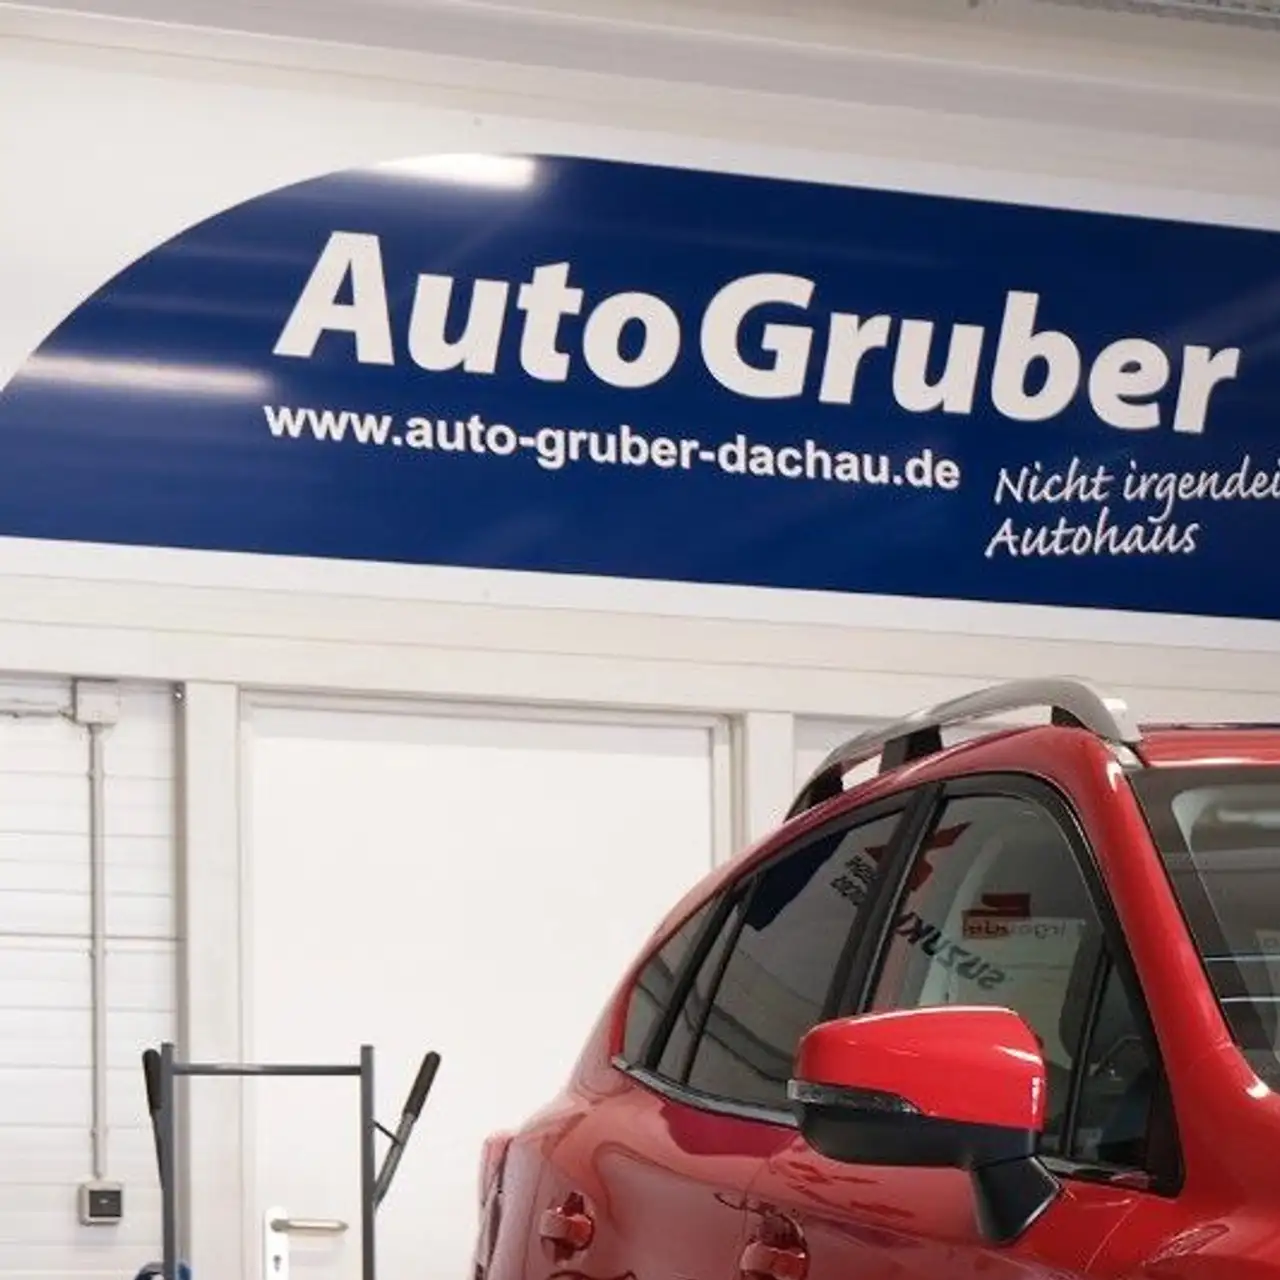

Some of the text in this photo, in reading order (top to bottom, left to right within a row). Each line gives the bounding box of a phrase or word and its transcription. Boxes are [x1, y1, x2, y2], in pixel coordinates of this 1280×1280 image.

[272, 230, 1240, 433] Auto Gruber
[263, 404, 960, 489] www.auto-gruber-dachau.de
[994, 456, 1115, 504] Nicht
[984, 506, 1200, 559] Autohaus
